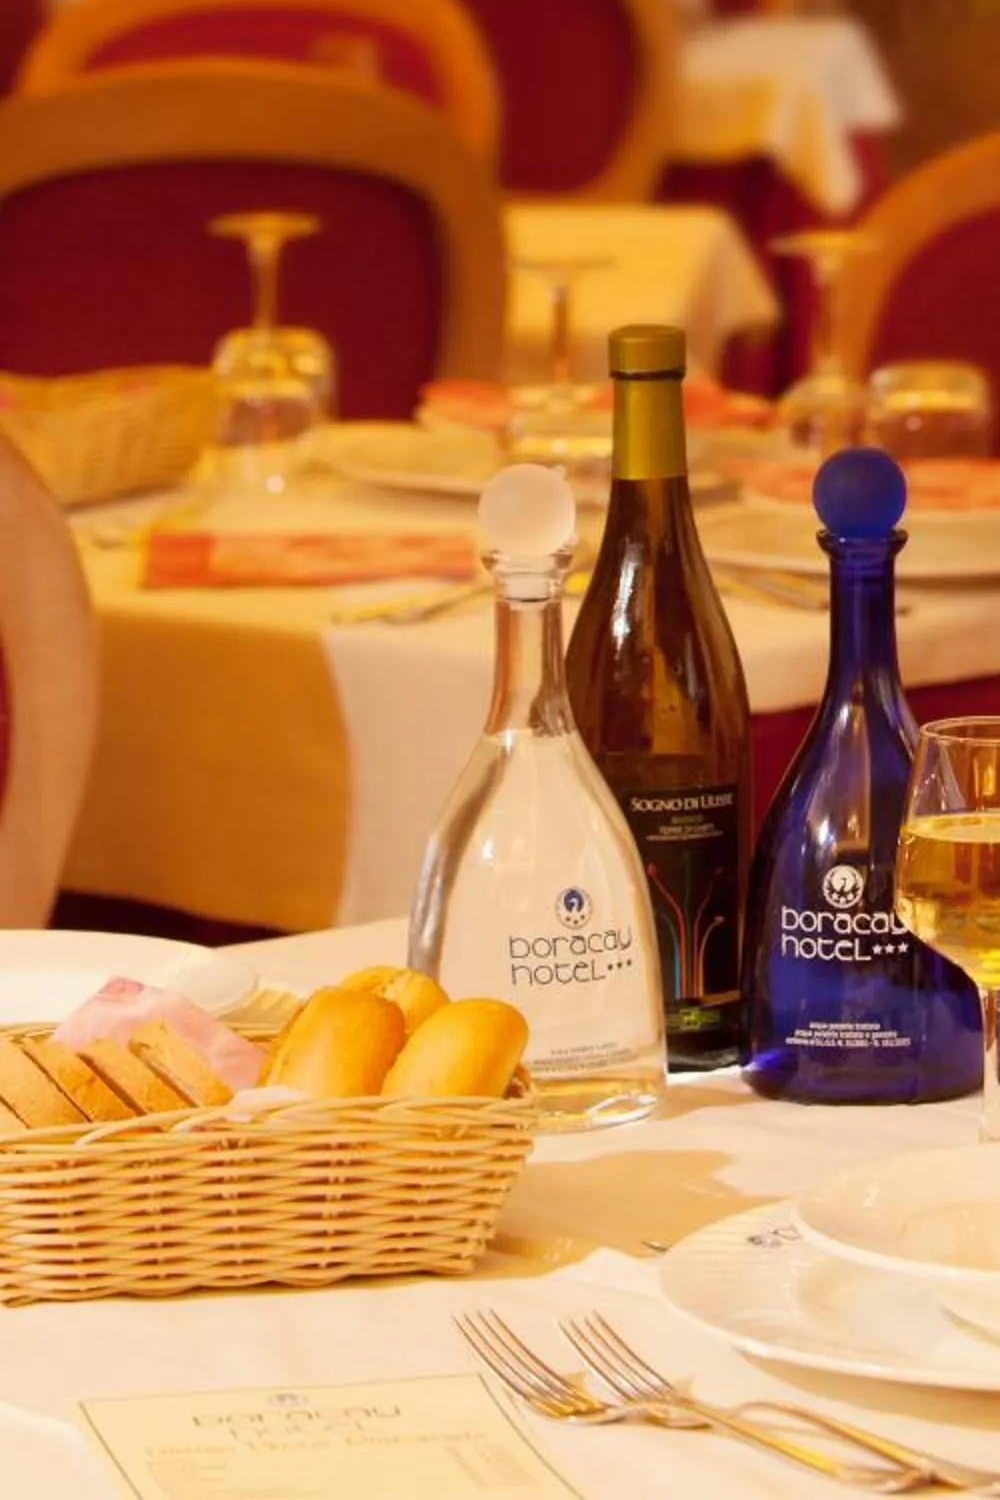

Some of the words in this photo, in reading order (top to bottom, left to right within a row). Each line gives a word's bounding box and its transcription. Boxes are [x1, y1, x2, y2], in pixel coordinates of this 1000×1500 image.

[781, 905, 910, 935] boracay
[509, 926, 632, 959] boracay
[781, 933, 872, 961] hotel
[511, 958, 606, 986] hotel
